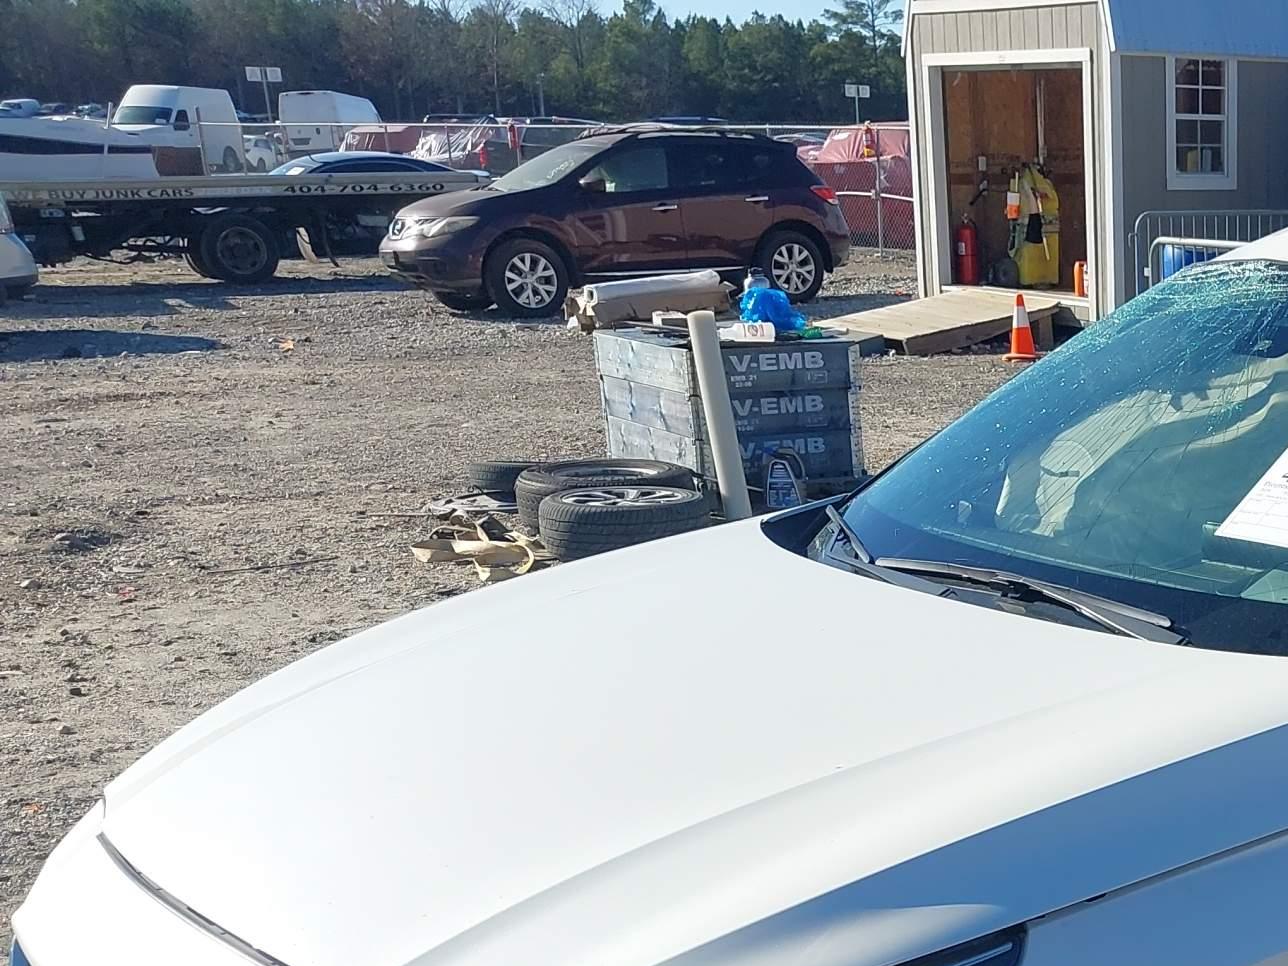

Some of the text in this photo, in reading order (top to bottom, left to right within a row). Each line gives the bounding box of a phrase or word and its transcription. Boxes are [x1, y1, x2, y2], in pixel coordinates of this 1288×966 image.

[48, 189, 87, 199] BUY
[95, 188, 142, 199] JUNK
[147, 188, 194, 198] CARS
[283, 183, 445, 194] 404-704-6360
[728, 351, 825, 372] V-EMB
[731, 395, 825, 416] V-EMB
